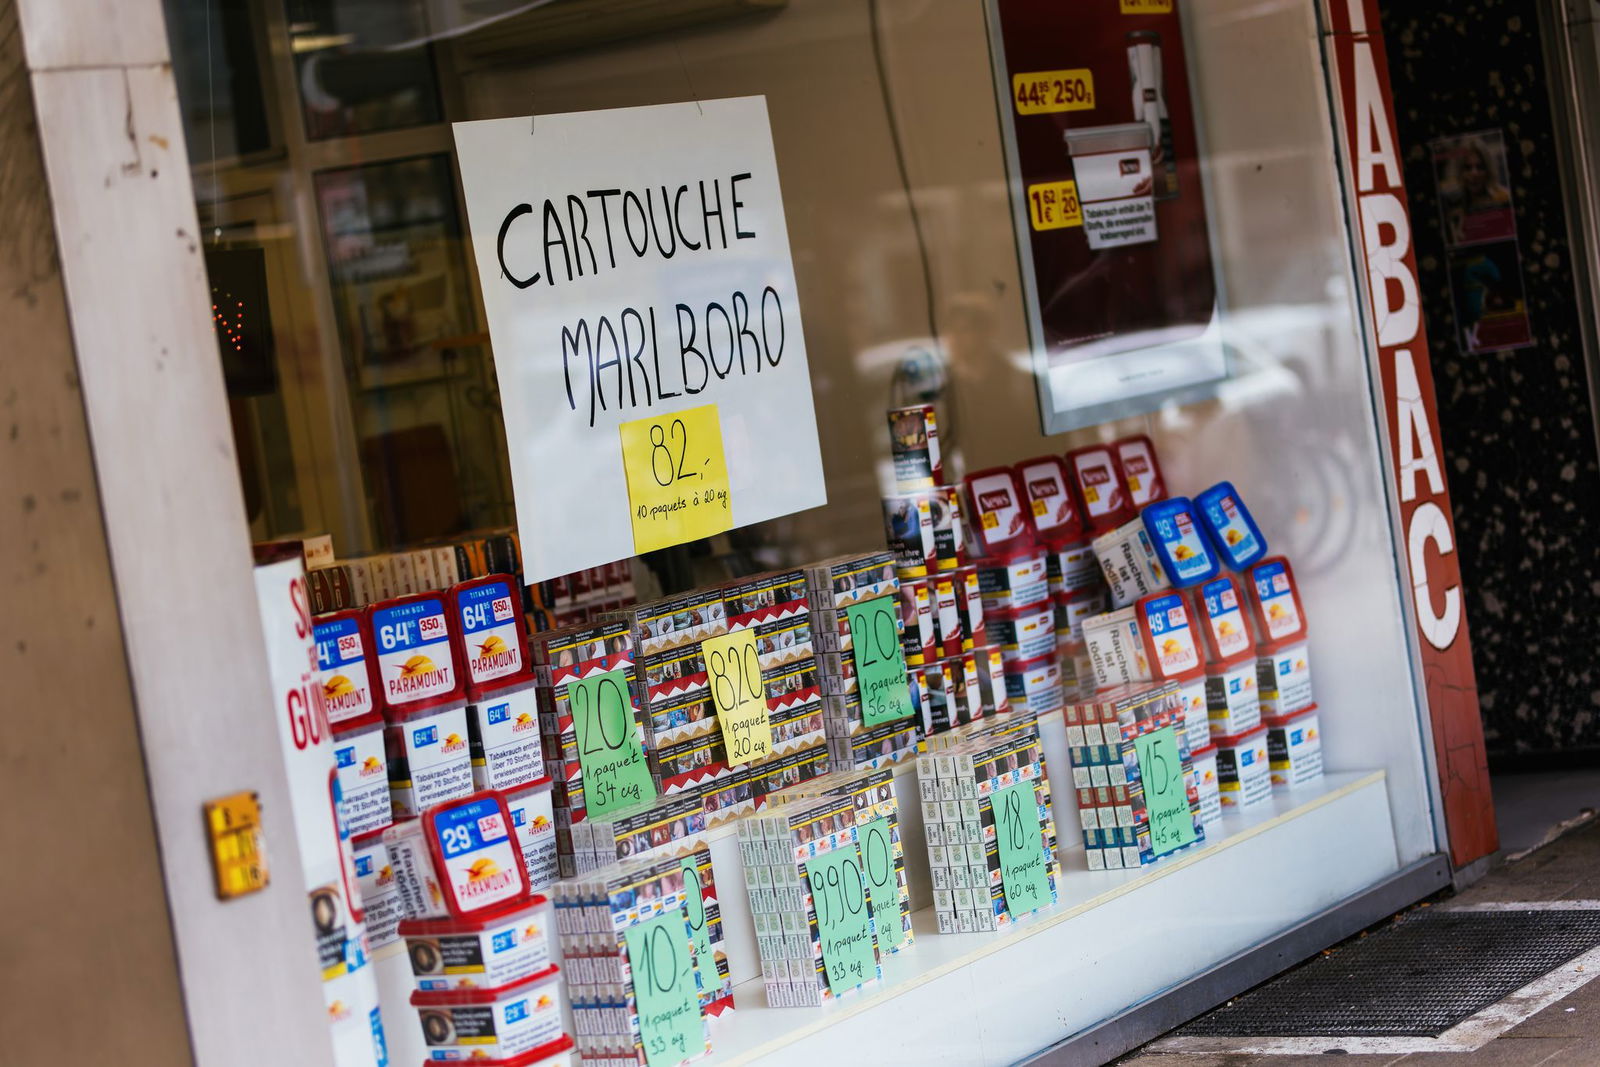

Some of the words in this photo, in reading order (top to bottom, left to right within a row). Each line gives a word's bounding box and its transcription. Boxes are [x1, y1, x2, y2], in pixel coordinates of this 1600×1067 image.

[1053, 78, 1085, 104] 250
[497, 172, 756, 289] CARTOUCHE
[561, 286, 784, 427] MARLBORO
[637, 505, 648, 519] 10
[650, 496, 687, 520] paquets
[692, 492, 700, 506] à
[704, 492, 715, 504] 20
[1103, 557, 1126, 600] tödlich
[1118, 565, 1131, 583] ist
[1121, 542, 1149, 596] Rauchen
[470, 590, 485, 599] TITAN
[486, 587, 496, 596] BOX
[463, 603, 487, 630] 64
[493, 599, 507, 613] 350
[339, 637, 355, 651] 350
[380, 622, 410, 650] 64
[420, 617, 438, 632] 350
[472, 648, 517, 675] PARAMOUNT
[1089, 640, 1107, 684] tödlich
[1104, 651, 1115, 668] ist
[1110, 629, 1131, 684] Rauchen
[389, 667, 449, 696] PARAMOUNT
[863, 683, 868, 695] 1
[870, 671, 905, 697] paquet
[724, 718, 730, 732] 1
[731, 708, 766, 735] paquet
[868, 699, 886, 717] 56
[733, 738, 750, 759] 20
[585, 767, 591, 780] 1
[594, 748, 640, 781] paquet
[595, 781, 617, 806] 54
[1156, 800, 1186, 826] paquet
[441, 824, 472, 855] 29
[1155, 828, 1167, 844] 45
[389, 846, 401, 866] ist
[1011, 857, 1041, 880] paquet
[402, 847, 427, 913] Rauchen
[459, 868, 516, 901] PARAMOUNT
[1009, 884, 1021, 900] 60
[826, 939, 833, 955] 1
[834, 923, 867, 955] paquet
[832, 961, 846, 981] 33
[652, 1001, 692, 1032] paquet
[650, 1034, 666, 1055] 33
